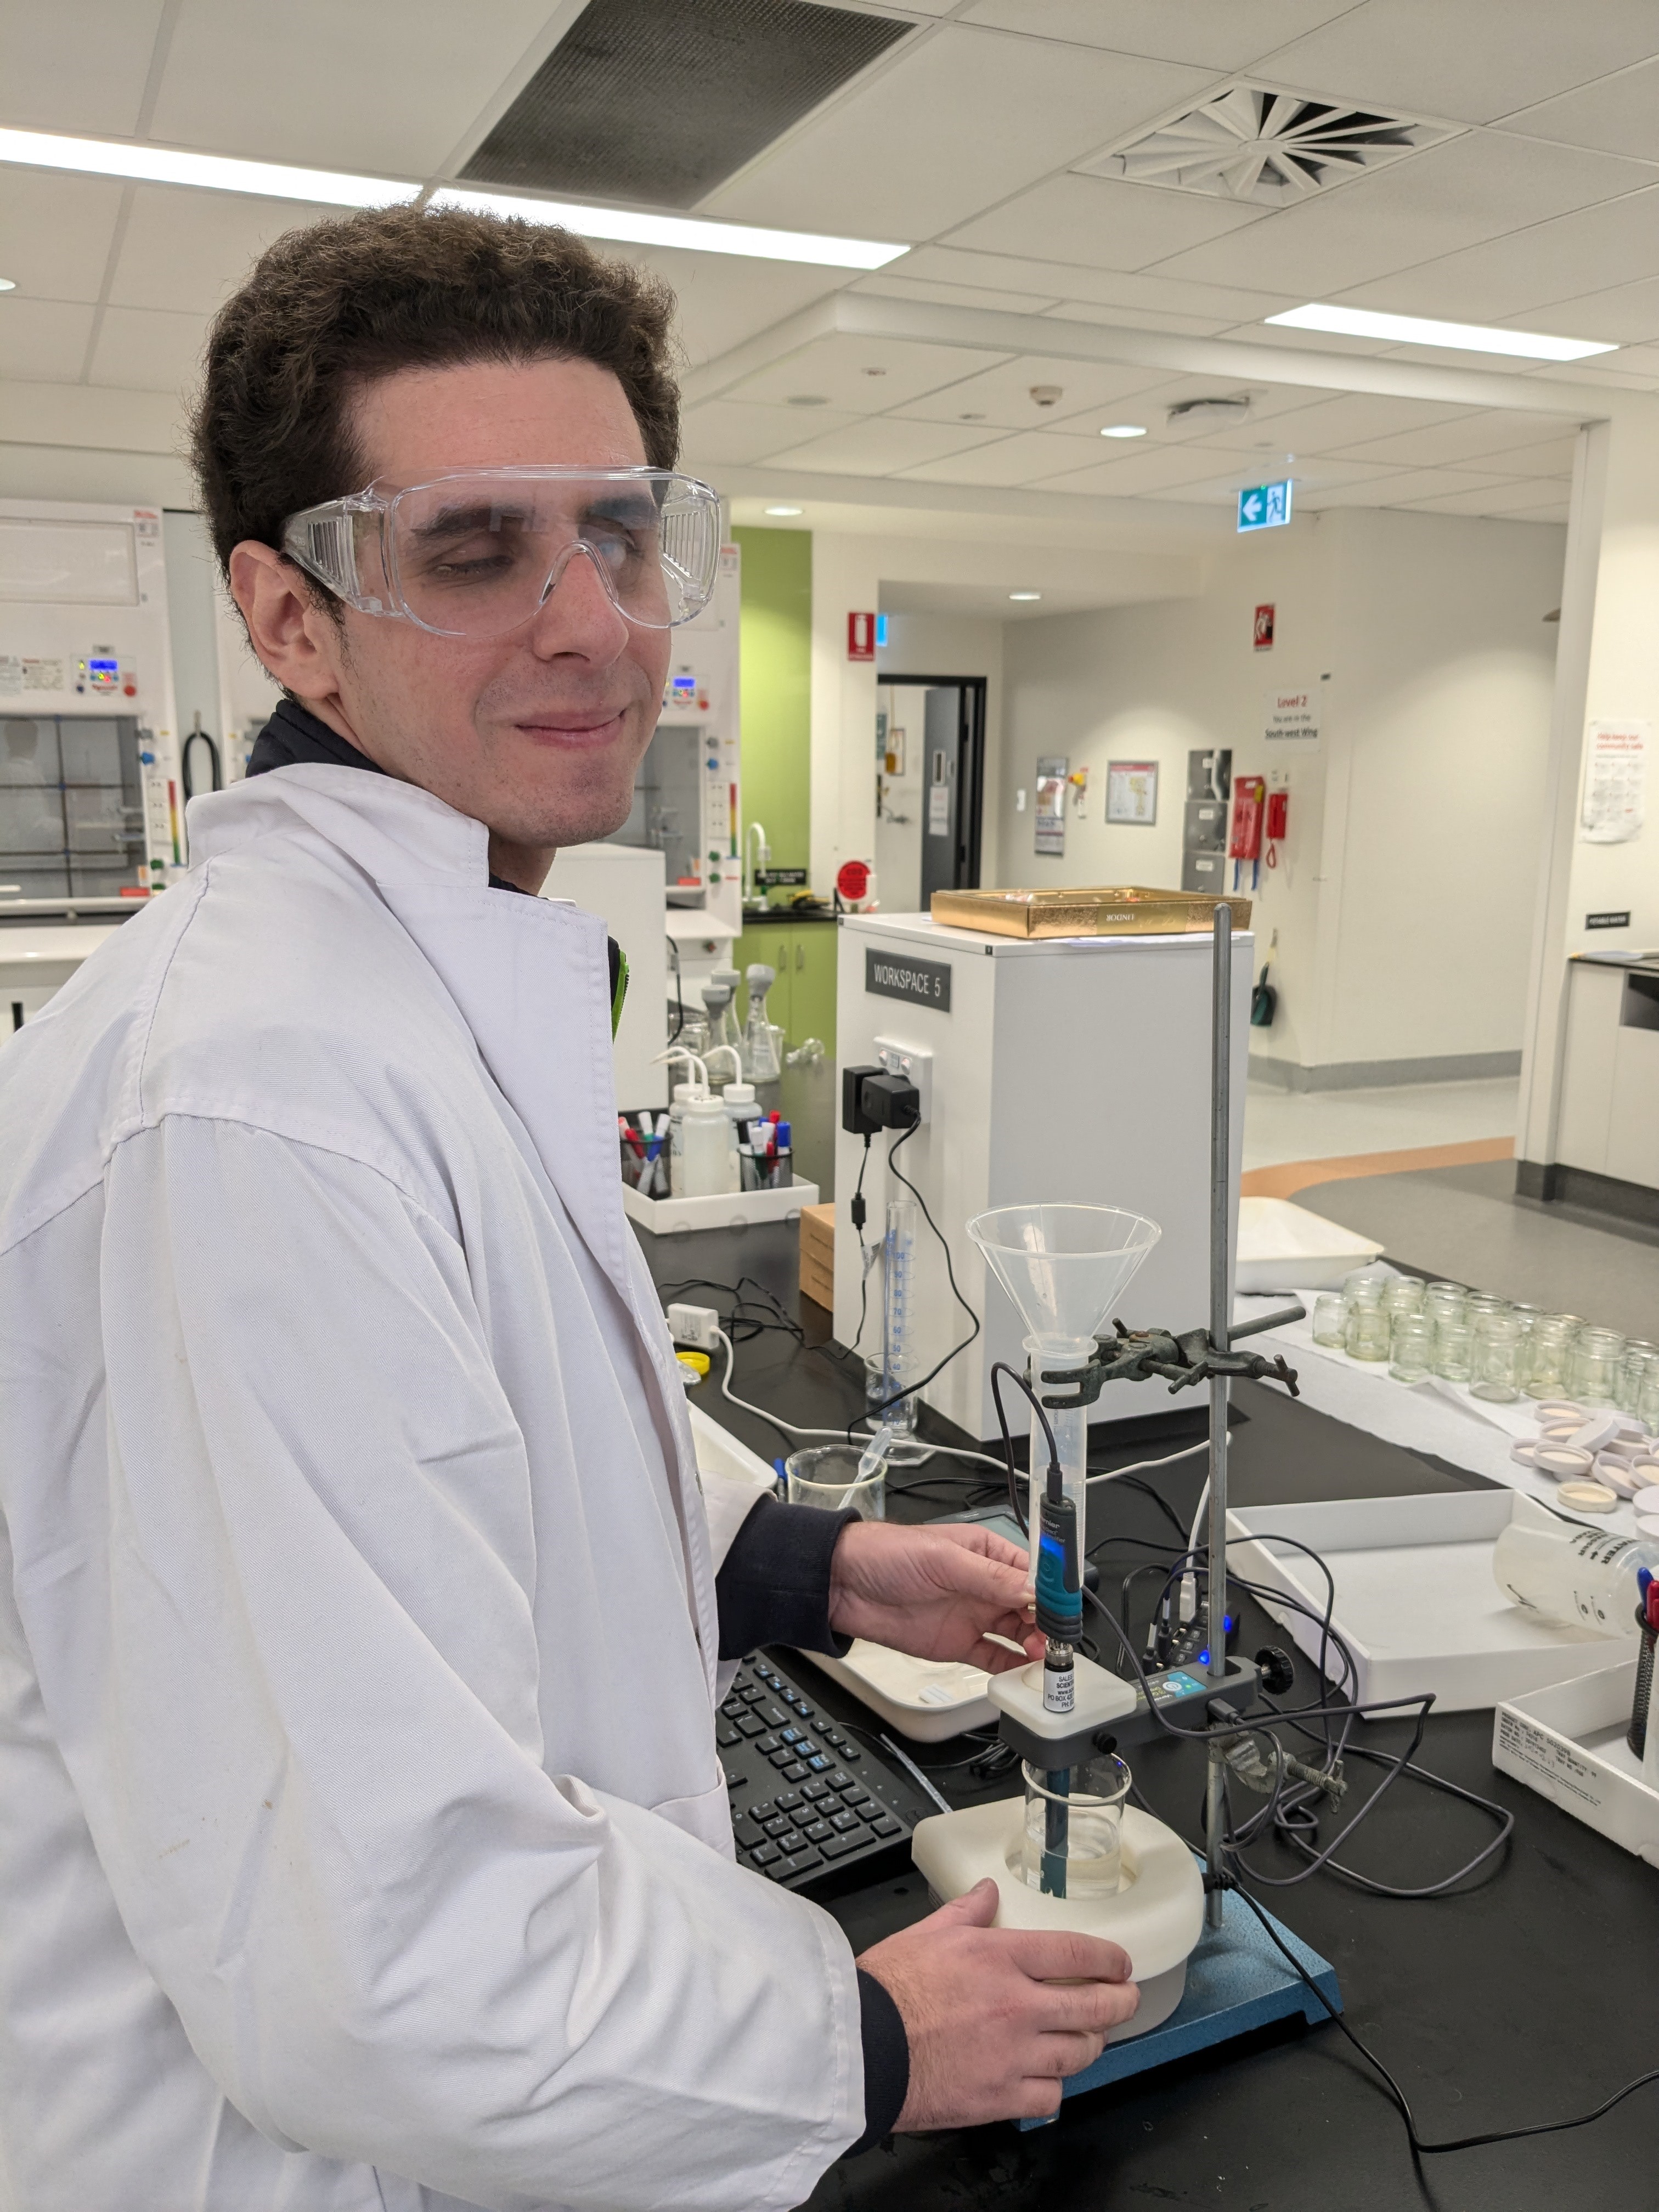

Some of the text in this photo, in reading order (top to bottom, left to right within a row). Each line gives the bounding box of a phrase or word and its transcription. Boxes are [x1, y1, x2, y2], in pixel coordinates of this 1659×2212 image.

[1277, 695, 1308, 708] Level 2
[1106, 913, 1136, 922] LINDOR
[874, 964, 941, 997] WORKSPACE 5
[1058, 1673, 1073, 1683] SALES
[1533, 1730, 1544, 1740] APC
